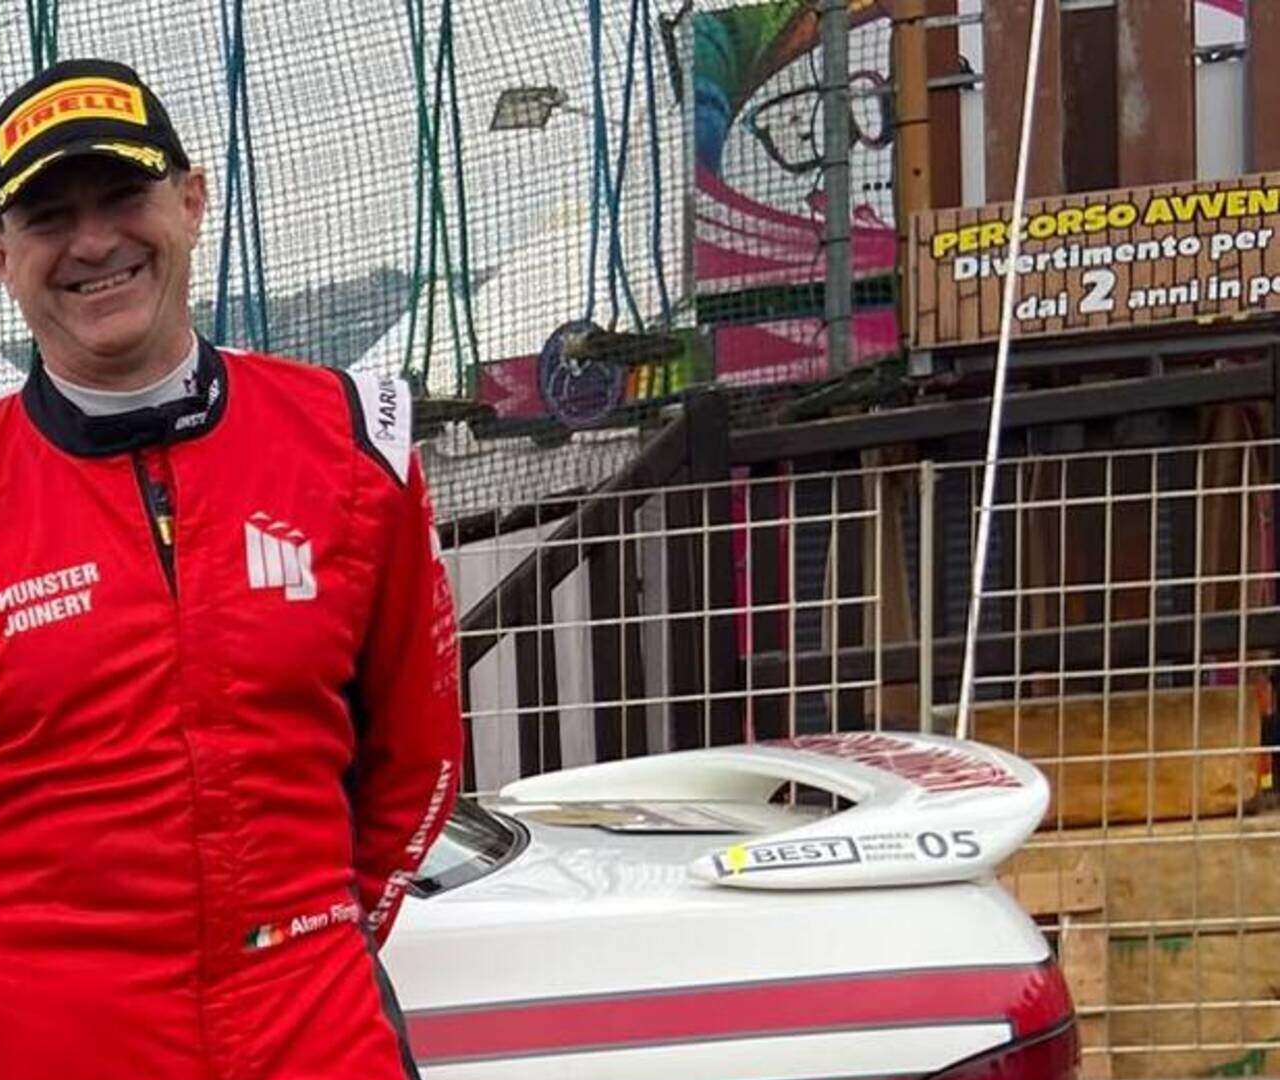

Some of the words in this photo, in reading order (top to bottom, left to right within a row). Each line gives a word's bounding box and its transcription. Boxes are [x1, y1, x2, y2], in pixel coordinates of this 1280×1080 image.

[2, 84, 136, 152] PIRELLI
[1144, 188, 1280, 225] AVVEN
[953, 234, 1201, 281] Divertimento
[1212, 227, 1273, 259] per
[1015, 292, 1068, 321] dai
[1080, 266, 1117, 315] 2
[1127, 278, 1198, 310] anni
[1208, 275, 1241, 301] in
[3, 590, 93, 638] JOINERY
[405, 758, 453, 860] JOINERY
[752, 841, 843, 865] BEST
[916, 829, 981, 859] 05
[289, 912, 329, 937] Alan
